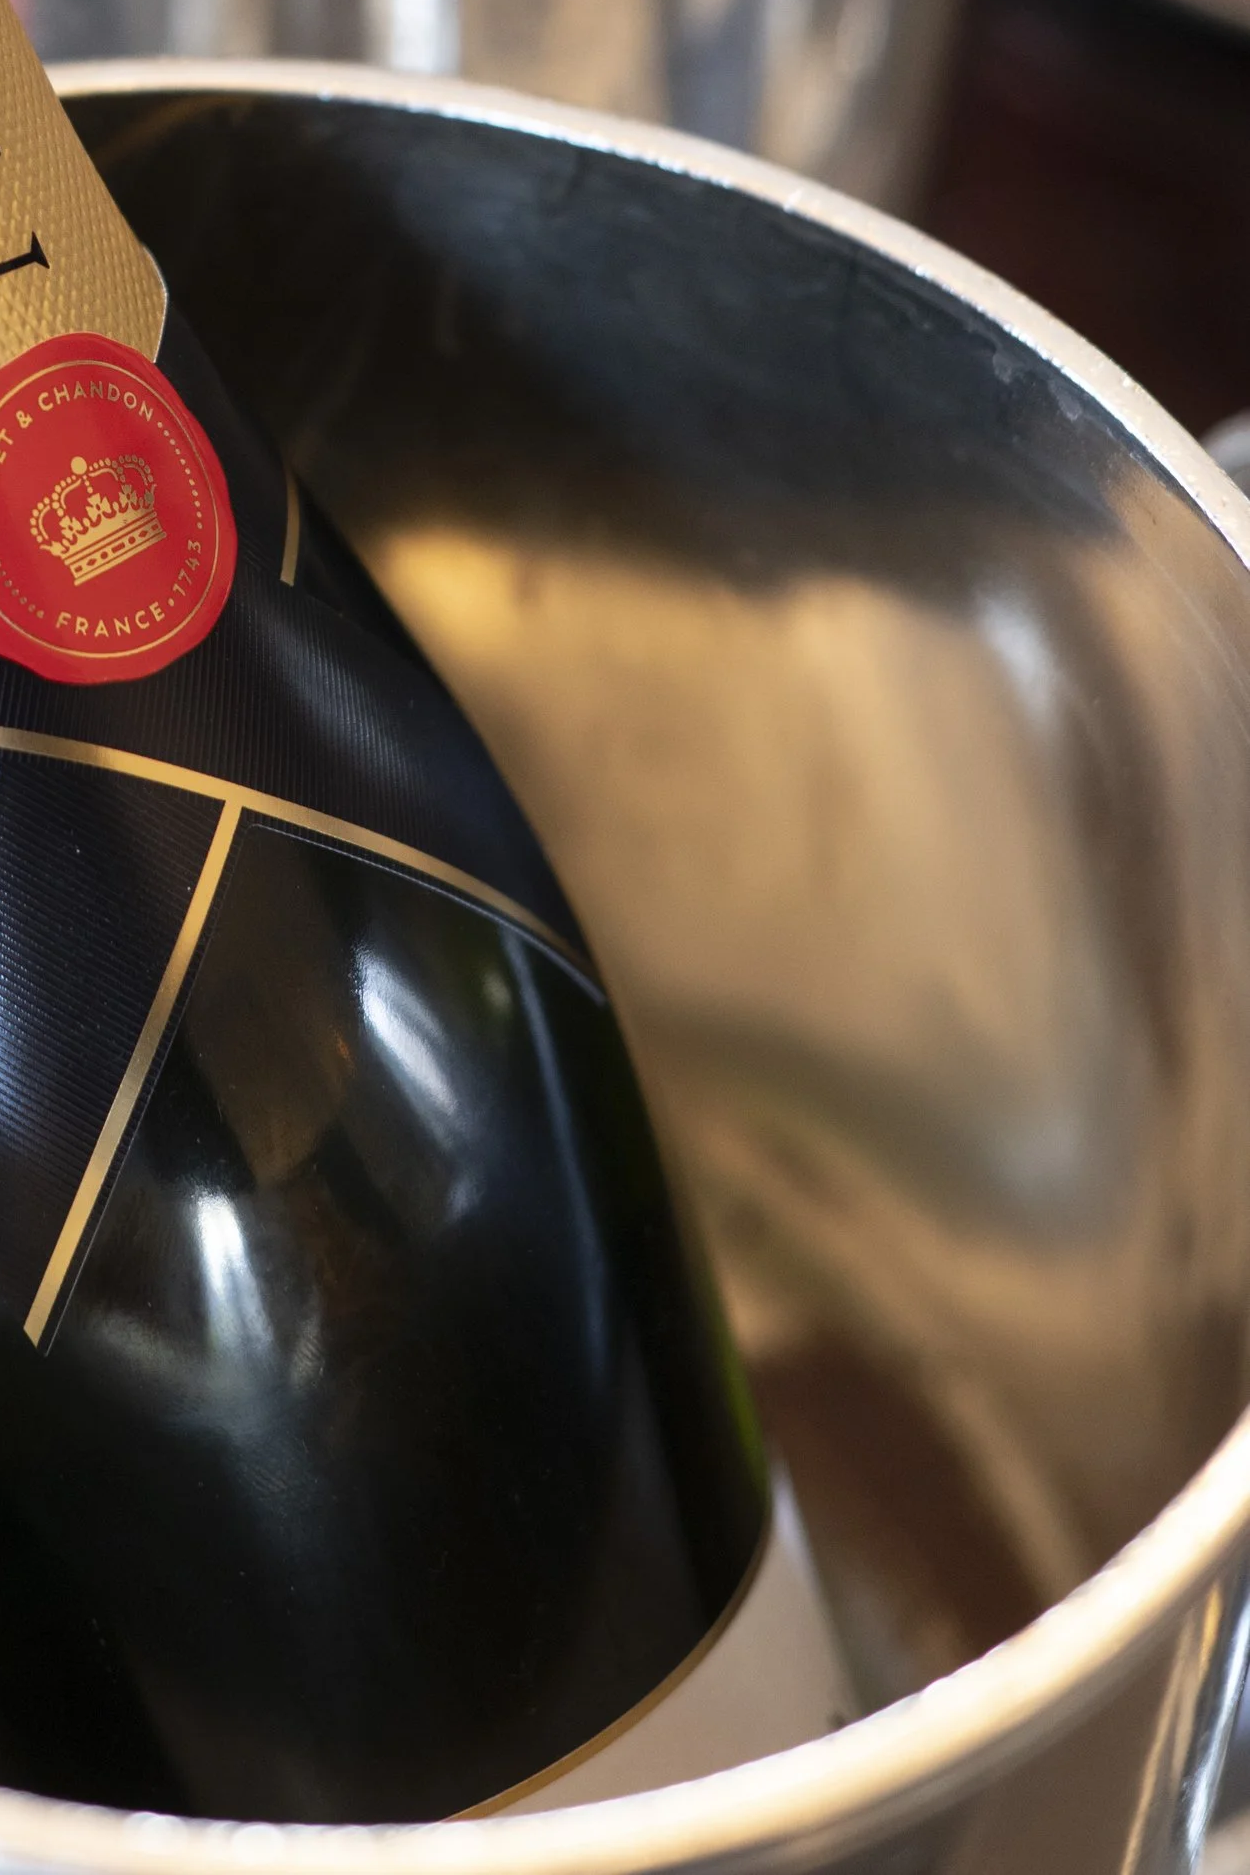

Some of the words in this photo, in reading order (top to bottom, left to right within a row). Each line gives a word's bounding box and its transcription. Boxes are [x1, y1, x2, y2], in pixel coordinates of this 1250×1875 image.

[15, 410, 33, 428] &
[37, 381, 154, 422] CHANDON
[56, 602, 165, 638] FRANCE
[172, 539, 202, 597] 1743
